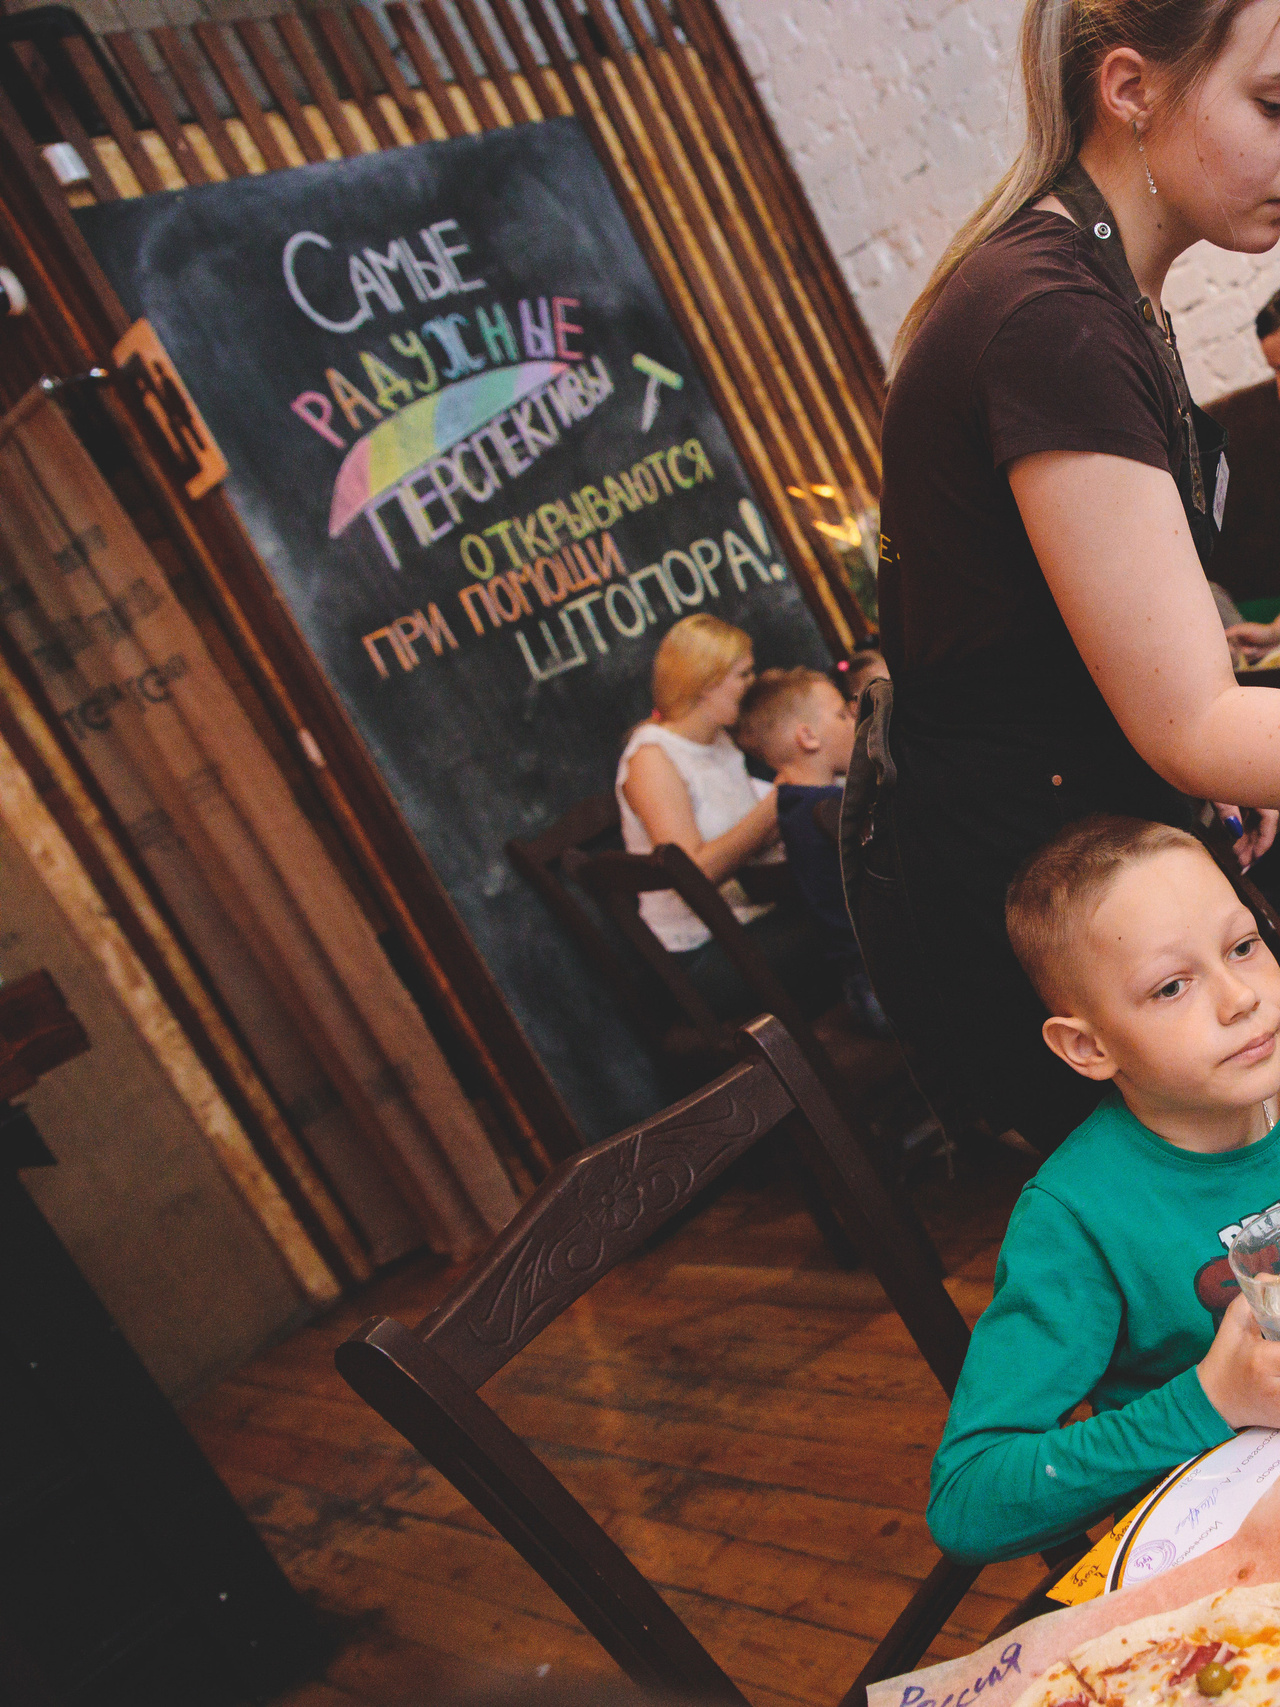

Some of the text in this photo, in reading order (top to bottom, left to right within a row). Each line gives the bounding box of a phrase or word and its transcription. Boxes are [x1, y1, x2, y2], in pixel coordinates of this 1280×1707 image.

[290, 296, 585, 449] РАДУЖНЫЕ
[363, 354, 615, 571] ПЕРСПЕКТИВЫ
[459, 438, 715, 582] ОТКРЫВАЮТСЯ
[361, 531, 629, 680] ПРИ ПОМОЩИ
[515, 497, 787, 683] ШТОПОРА!
